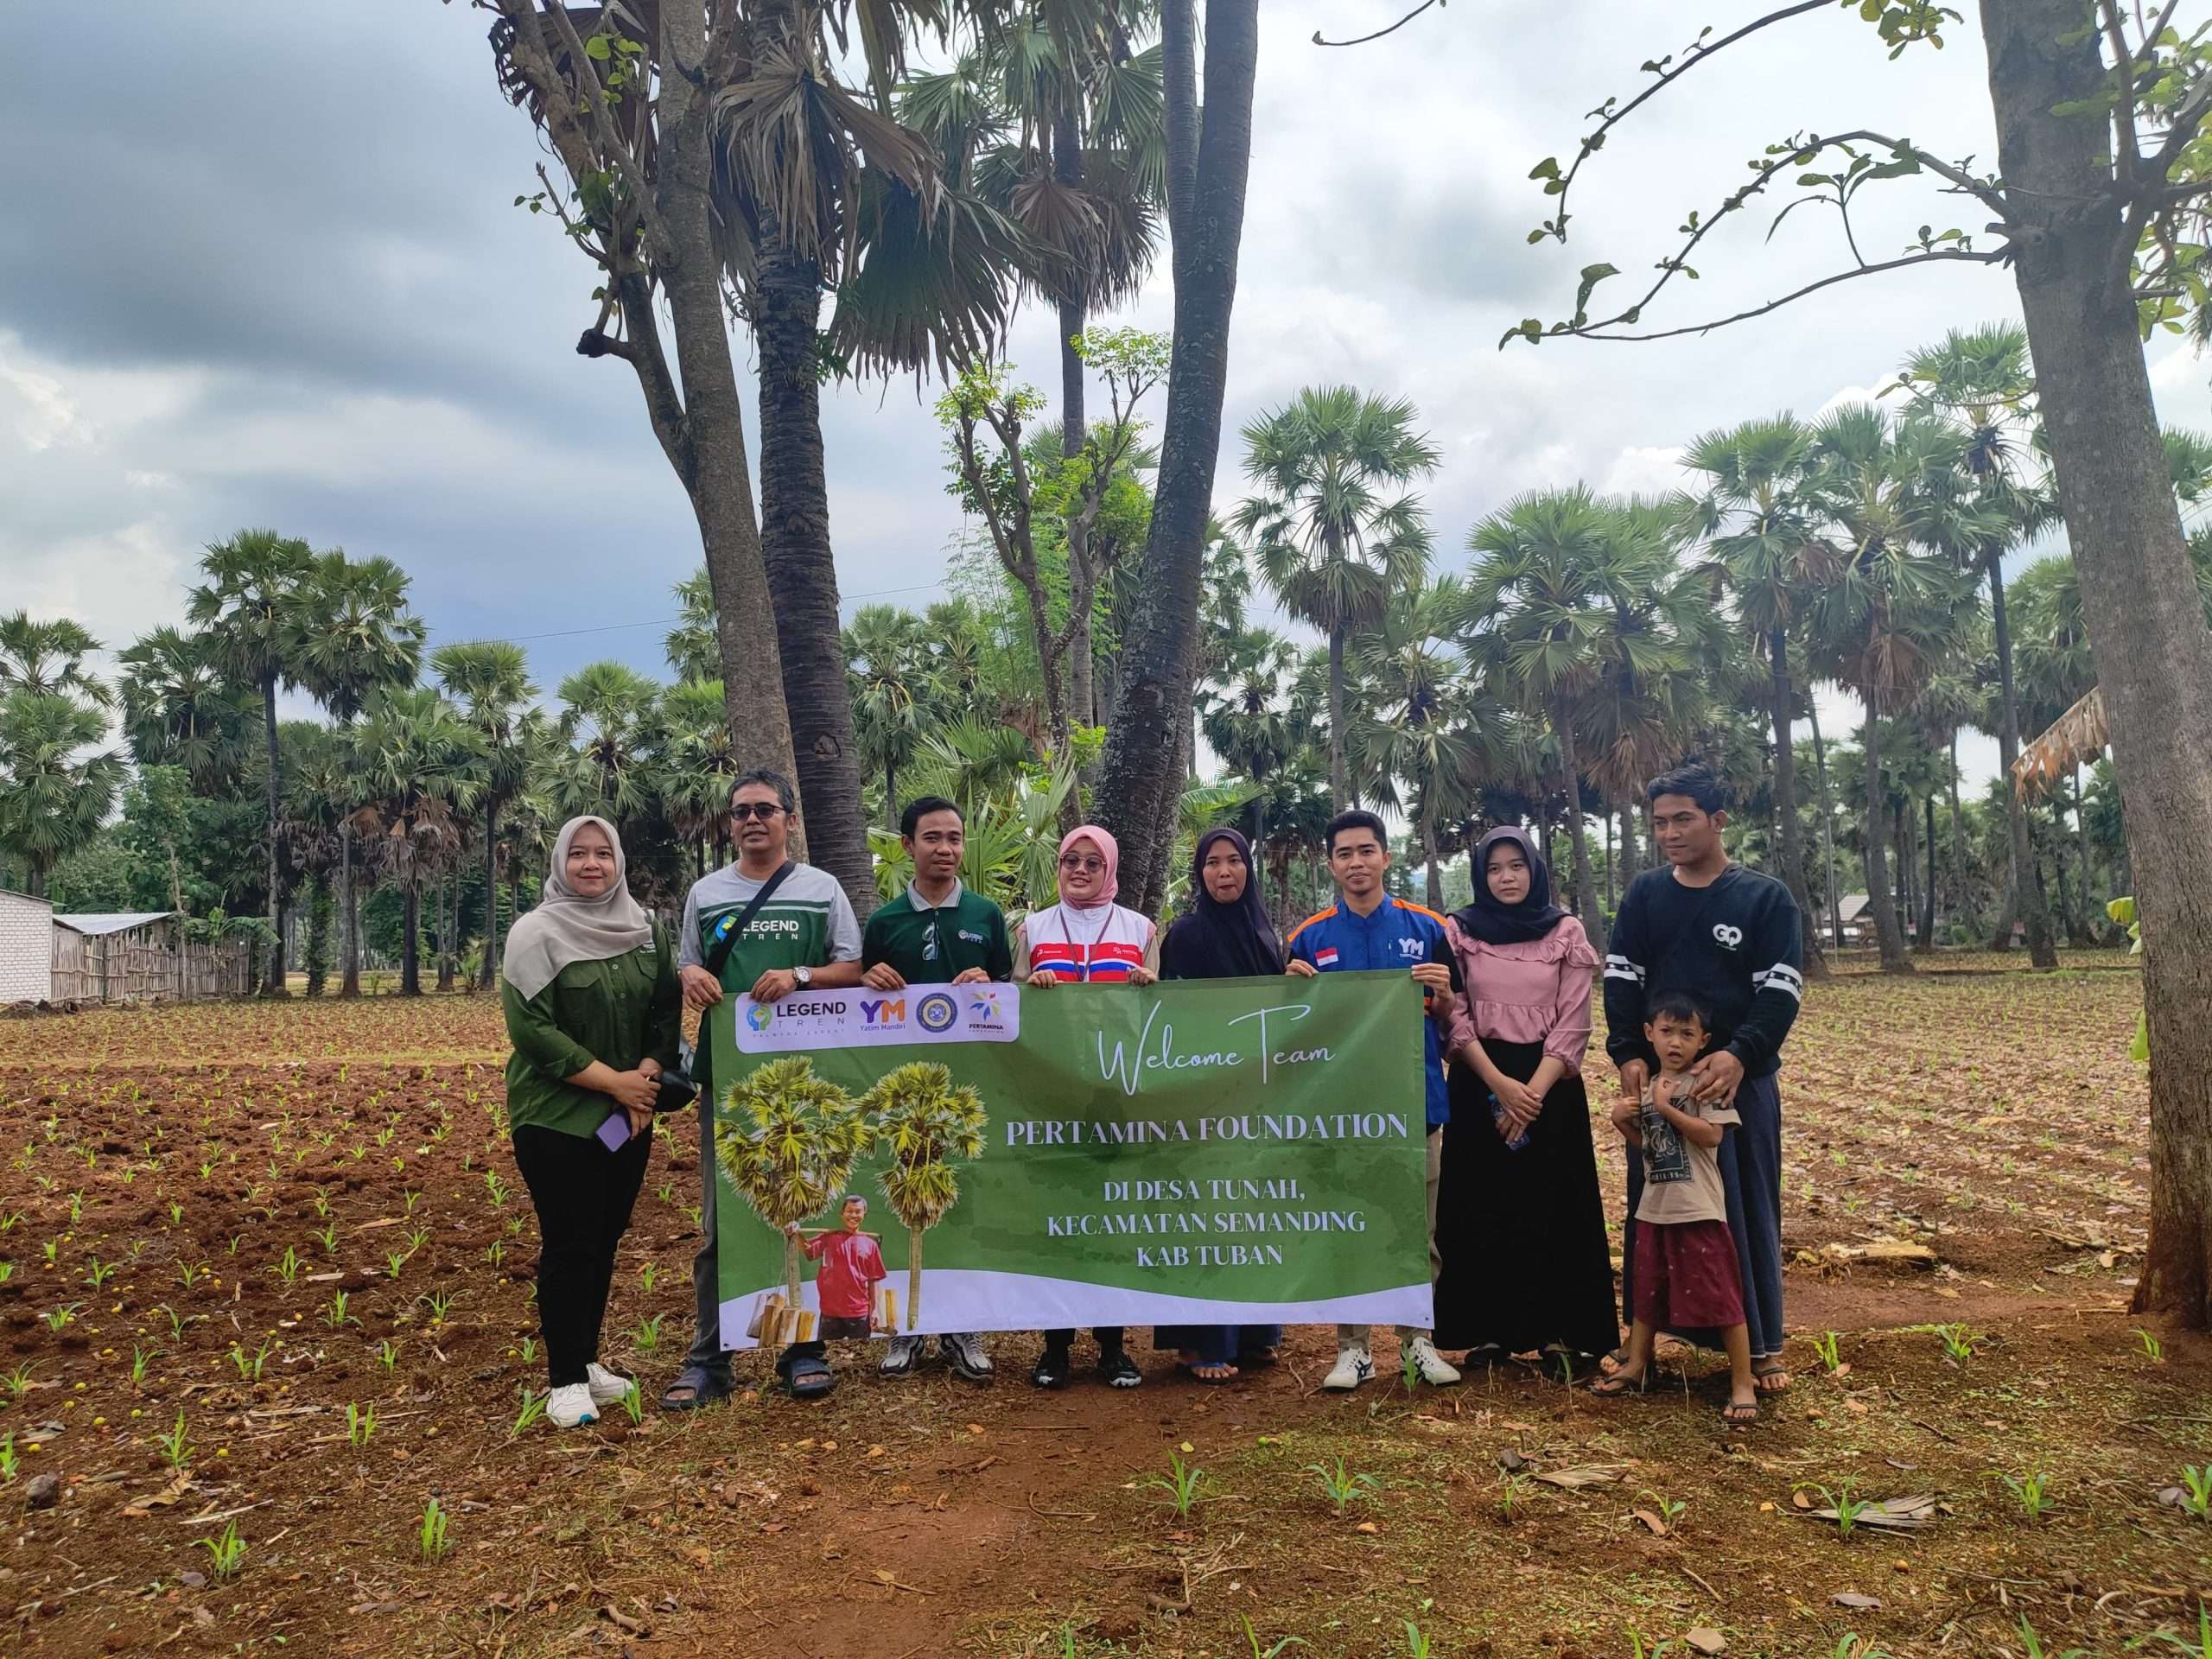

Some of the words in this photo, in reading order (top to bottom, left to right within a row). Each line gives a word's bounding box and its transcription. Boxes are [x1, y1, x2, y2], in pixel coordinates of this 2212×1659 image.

[1398, 938, 1425, 956] YM
[776, 1001, 847, 1018] LEGEND
[860, 998, 906, 1023] YM
[777, 1017, 845, 1029] TREN
[1098, 999, 1244, 1096] Welcome
[1228, 1004, 1336, 1084] Team
[1006, 1118, 1190, 1147] PERTAMINA
[1199, 1112, 1408, 1141] FOUNDATION
[1104, 1180, 1128, 1202] DI
[1135, 1179, 1201, 1202] DESA
[1207, 1179, 1306, 1202] TUNAH,
[1047, 1212, 1207, 1236] KECAMATAN
[1214, 1210, 1366, 1233] SEMANDING
[1136, 1246, 1189, 1267] KAB
[1195, 1244, 1284, 1266] TUBAN
